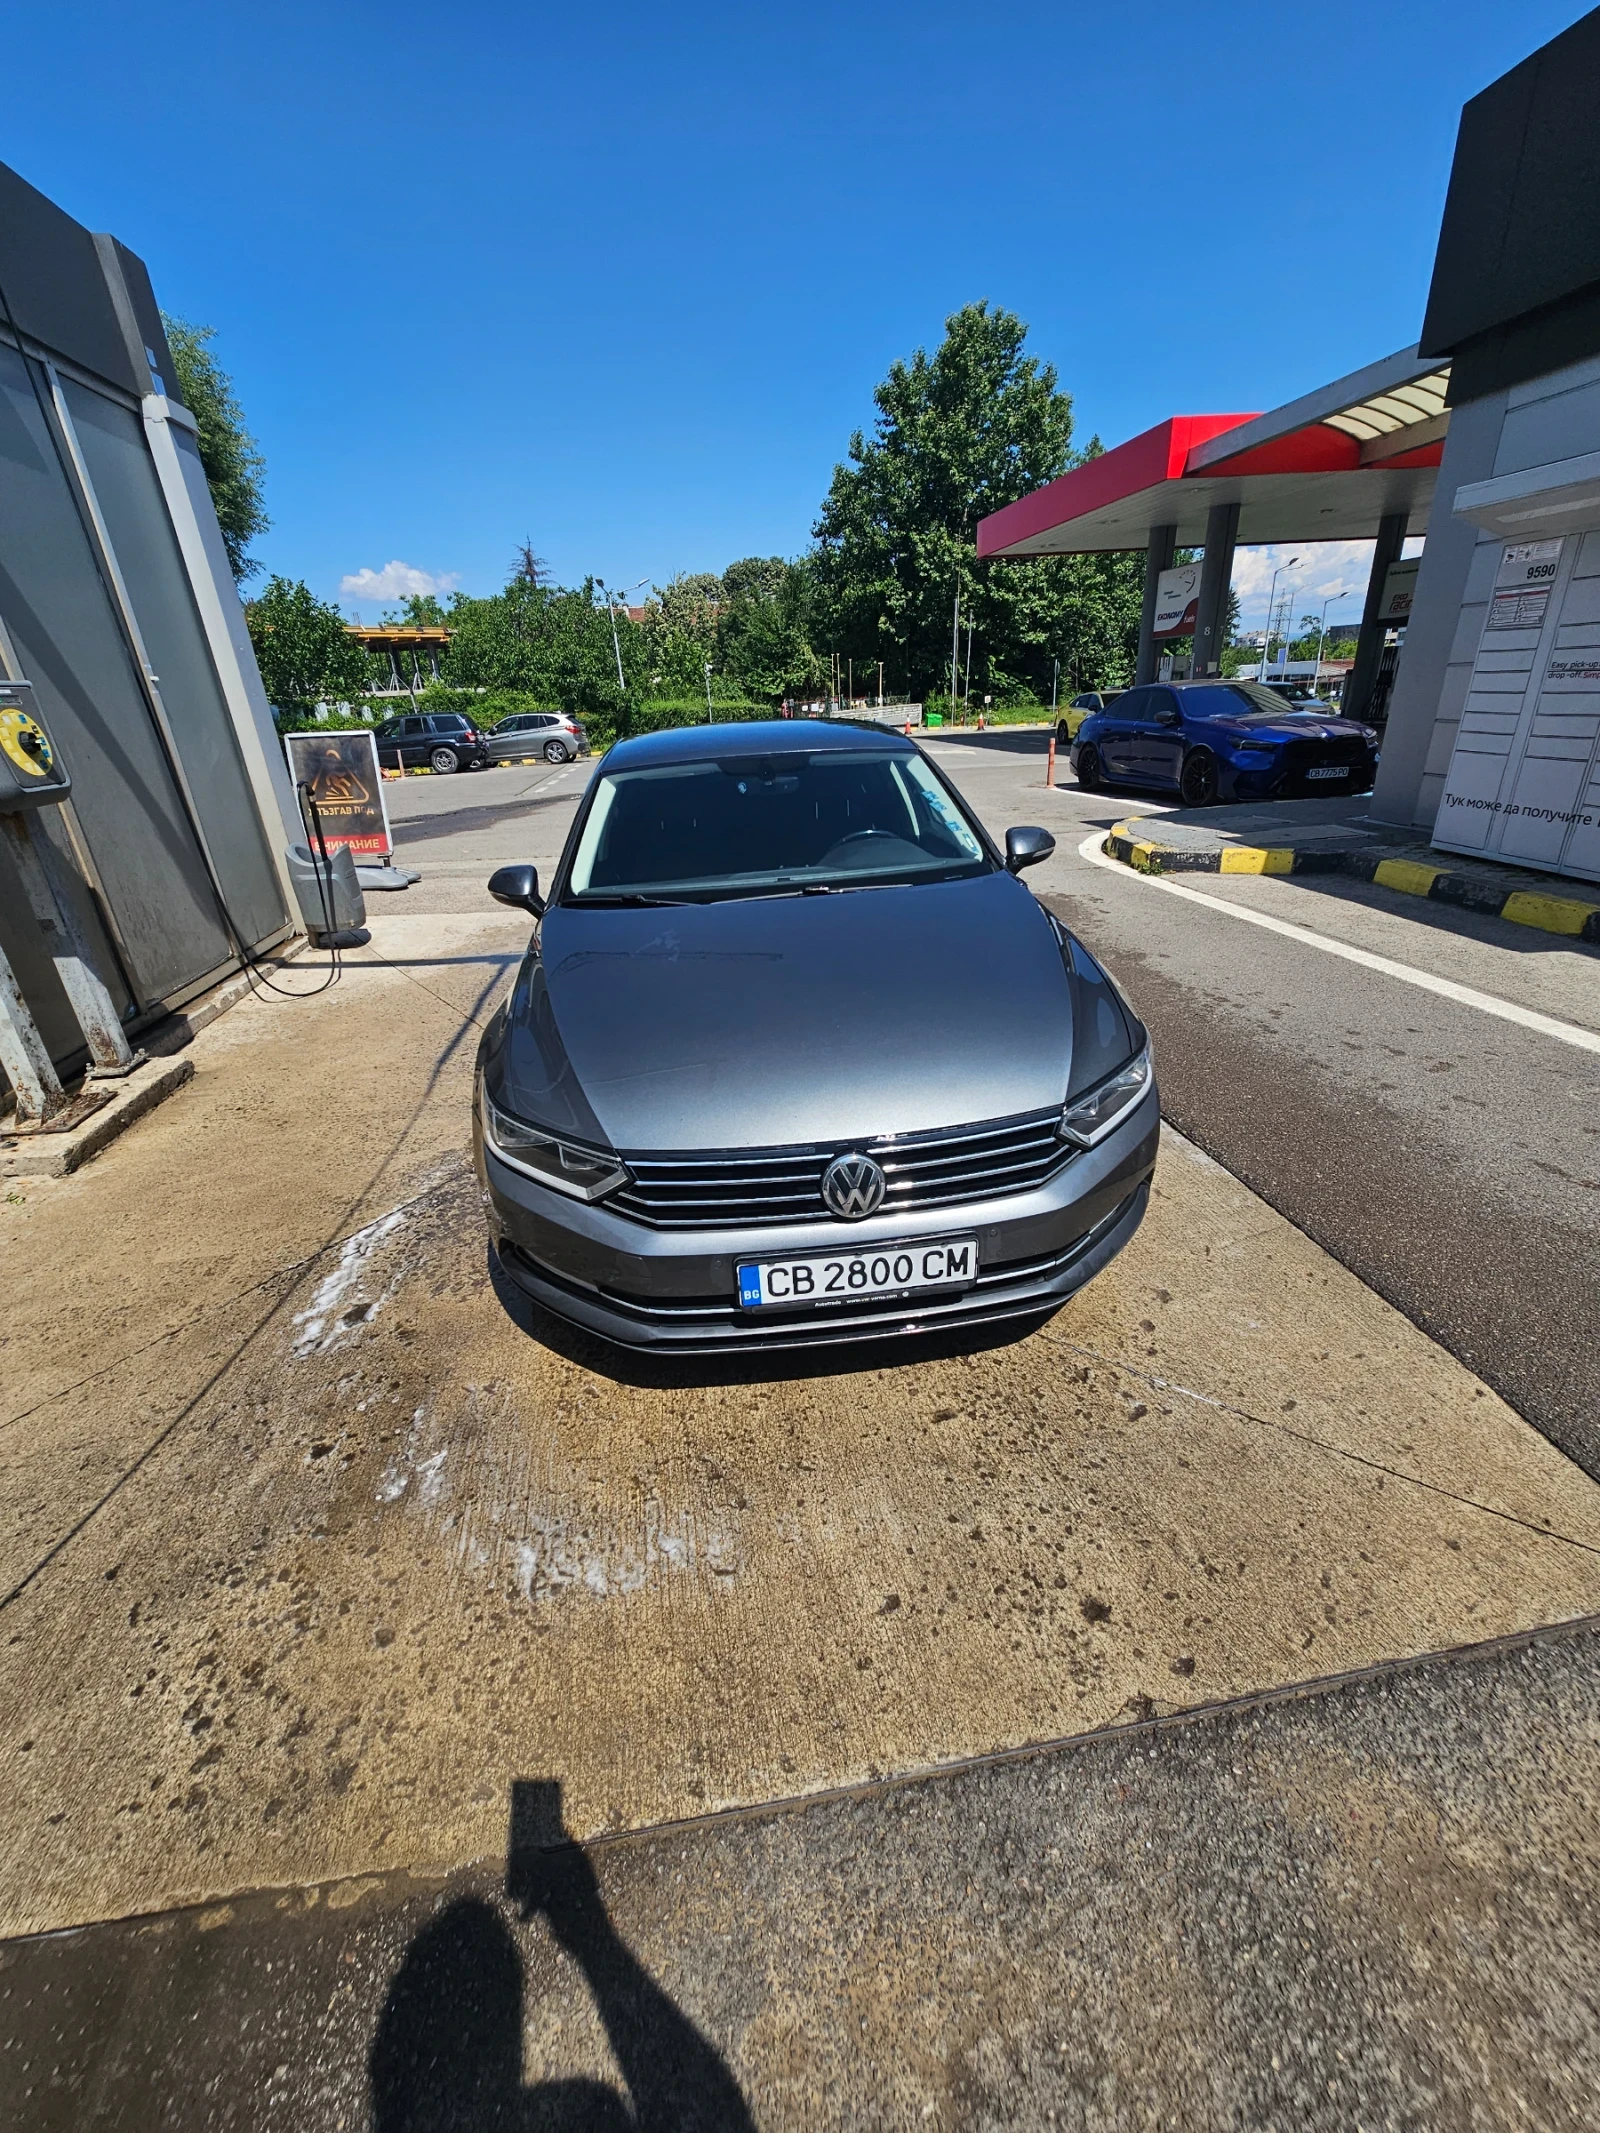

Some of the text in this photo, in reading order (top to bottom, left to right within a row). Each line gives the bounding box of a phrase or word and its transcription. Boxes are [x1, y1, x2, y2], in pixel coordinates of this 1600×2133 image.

[1526, 563, 1556, 579] 9590
[1158, 610, 1183, 620] EKONOMY
[1204, 627, 1210, 635] 8
[1551, 661, 1568, 670] Easy
[1445, 793, 1465, 807] Тук
[1467, 799, 1502, 812] може
[1503, 802, 1519, 815] да
[1522, 806, 1592, 826] получите
[767, 1246, 970, 1297] CB 2800 CM
[743, 1289, 760, 1301] BG
